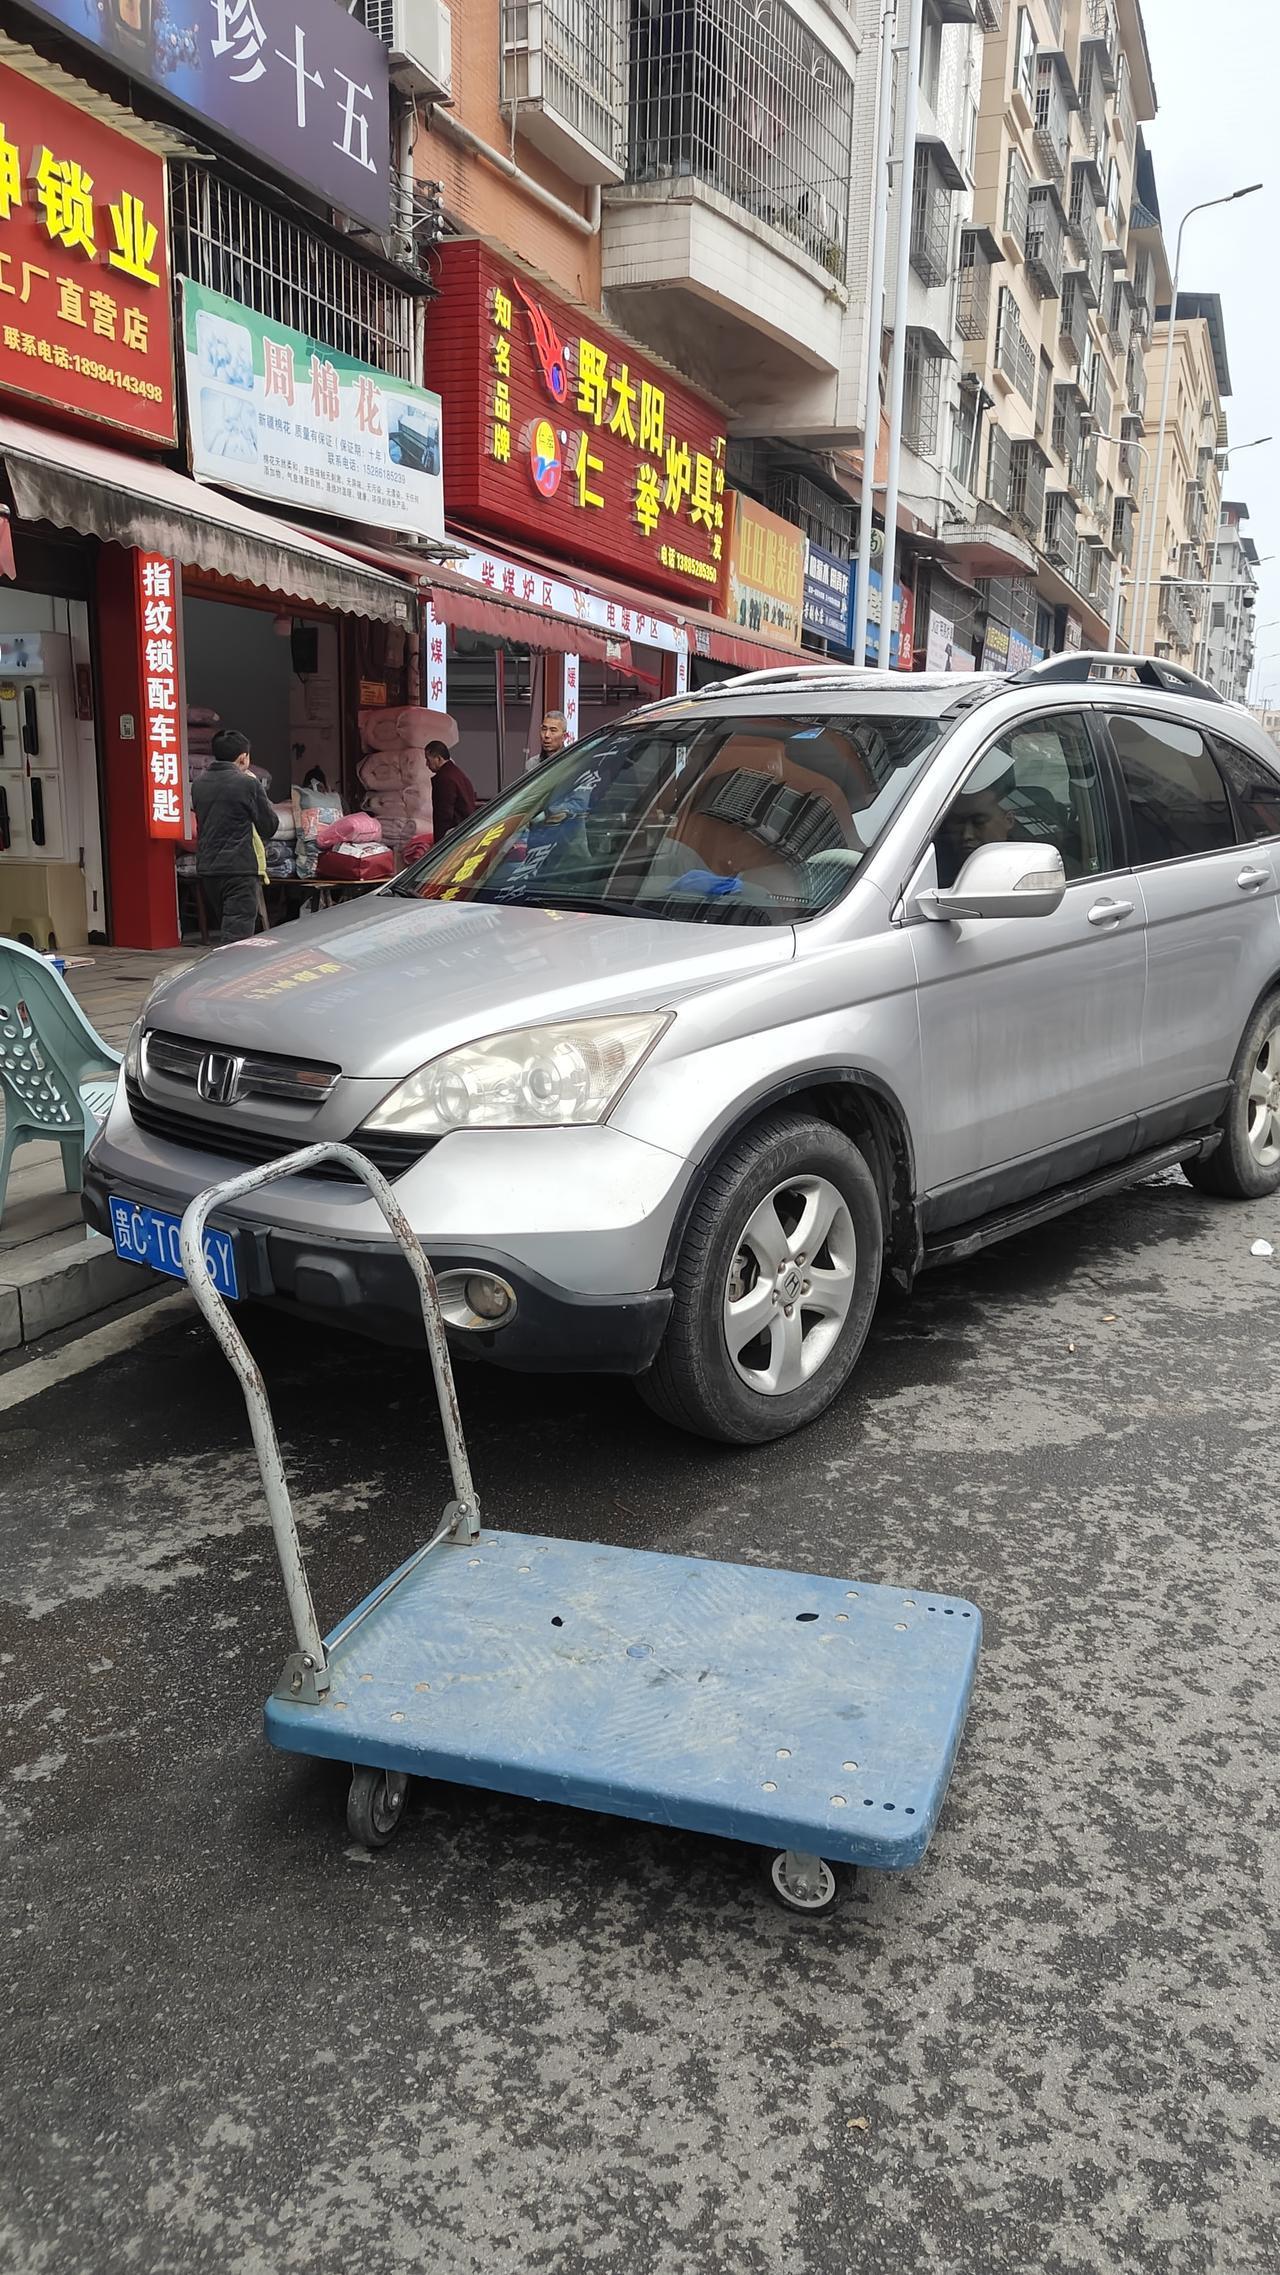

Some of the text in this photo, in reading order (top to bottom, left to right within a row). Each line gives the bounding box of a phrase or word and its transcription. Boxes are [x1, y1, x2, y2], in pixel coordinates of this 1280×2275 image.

[3, 325, 163, 403] 联系电话:18984143498
[263, 336, 383, 436] 周棉花
[493, 288, 512, 463] 知名品牌
[577, 337, 665, 457] 野太阳
[664, 436, 714, 530] 炉具
[713, 436, 726, 560] 厂价批发
[481, 560, 553, 610] 柴煤炉区
[606, 601, 659, 639] 电暖炉区
[142, 561, 181, 823] 指纹锁配车钥匙
[430, 603, 444, 701] 煤炉
[115, 1208, 230, 1287] 贵C·T06Y
